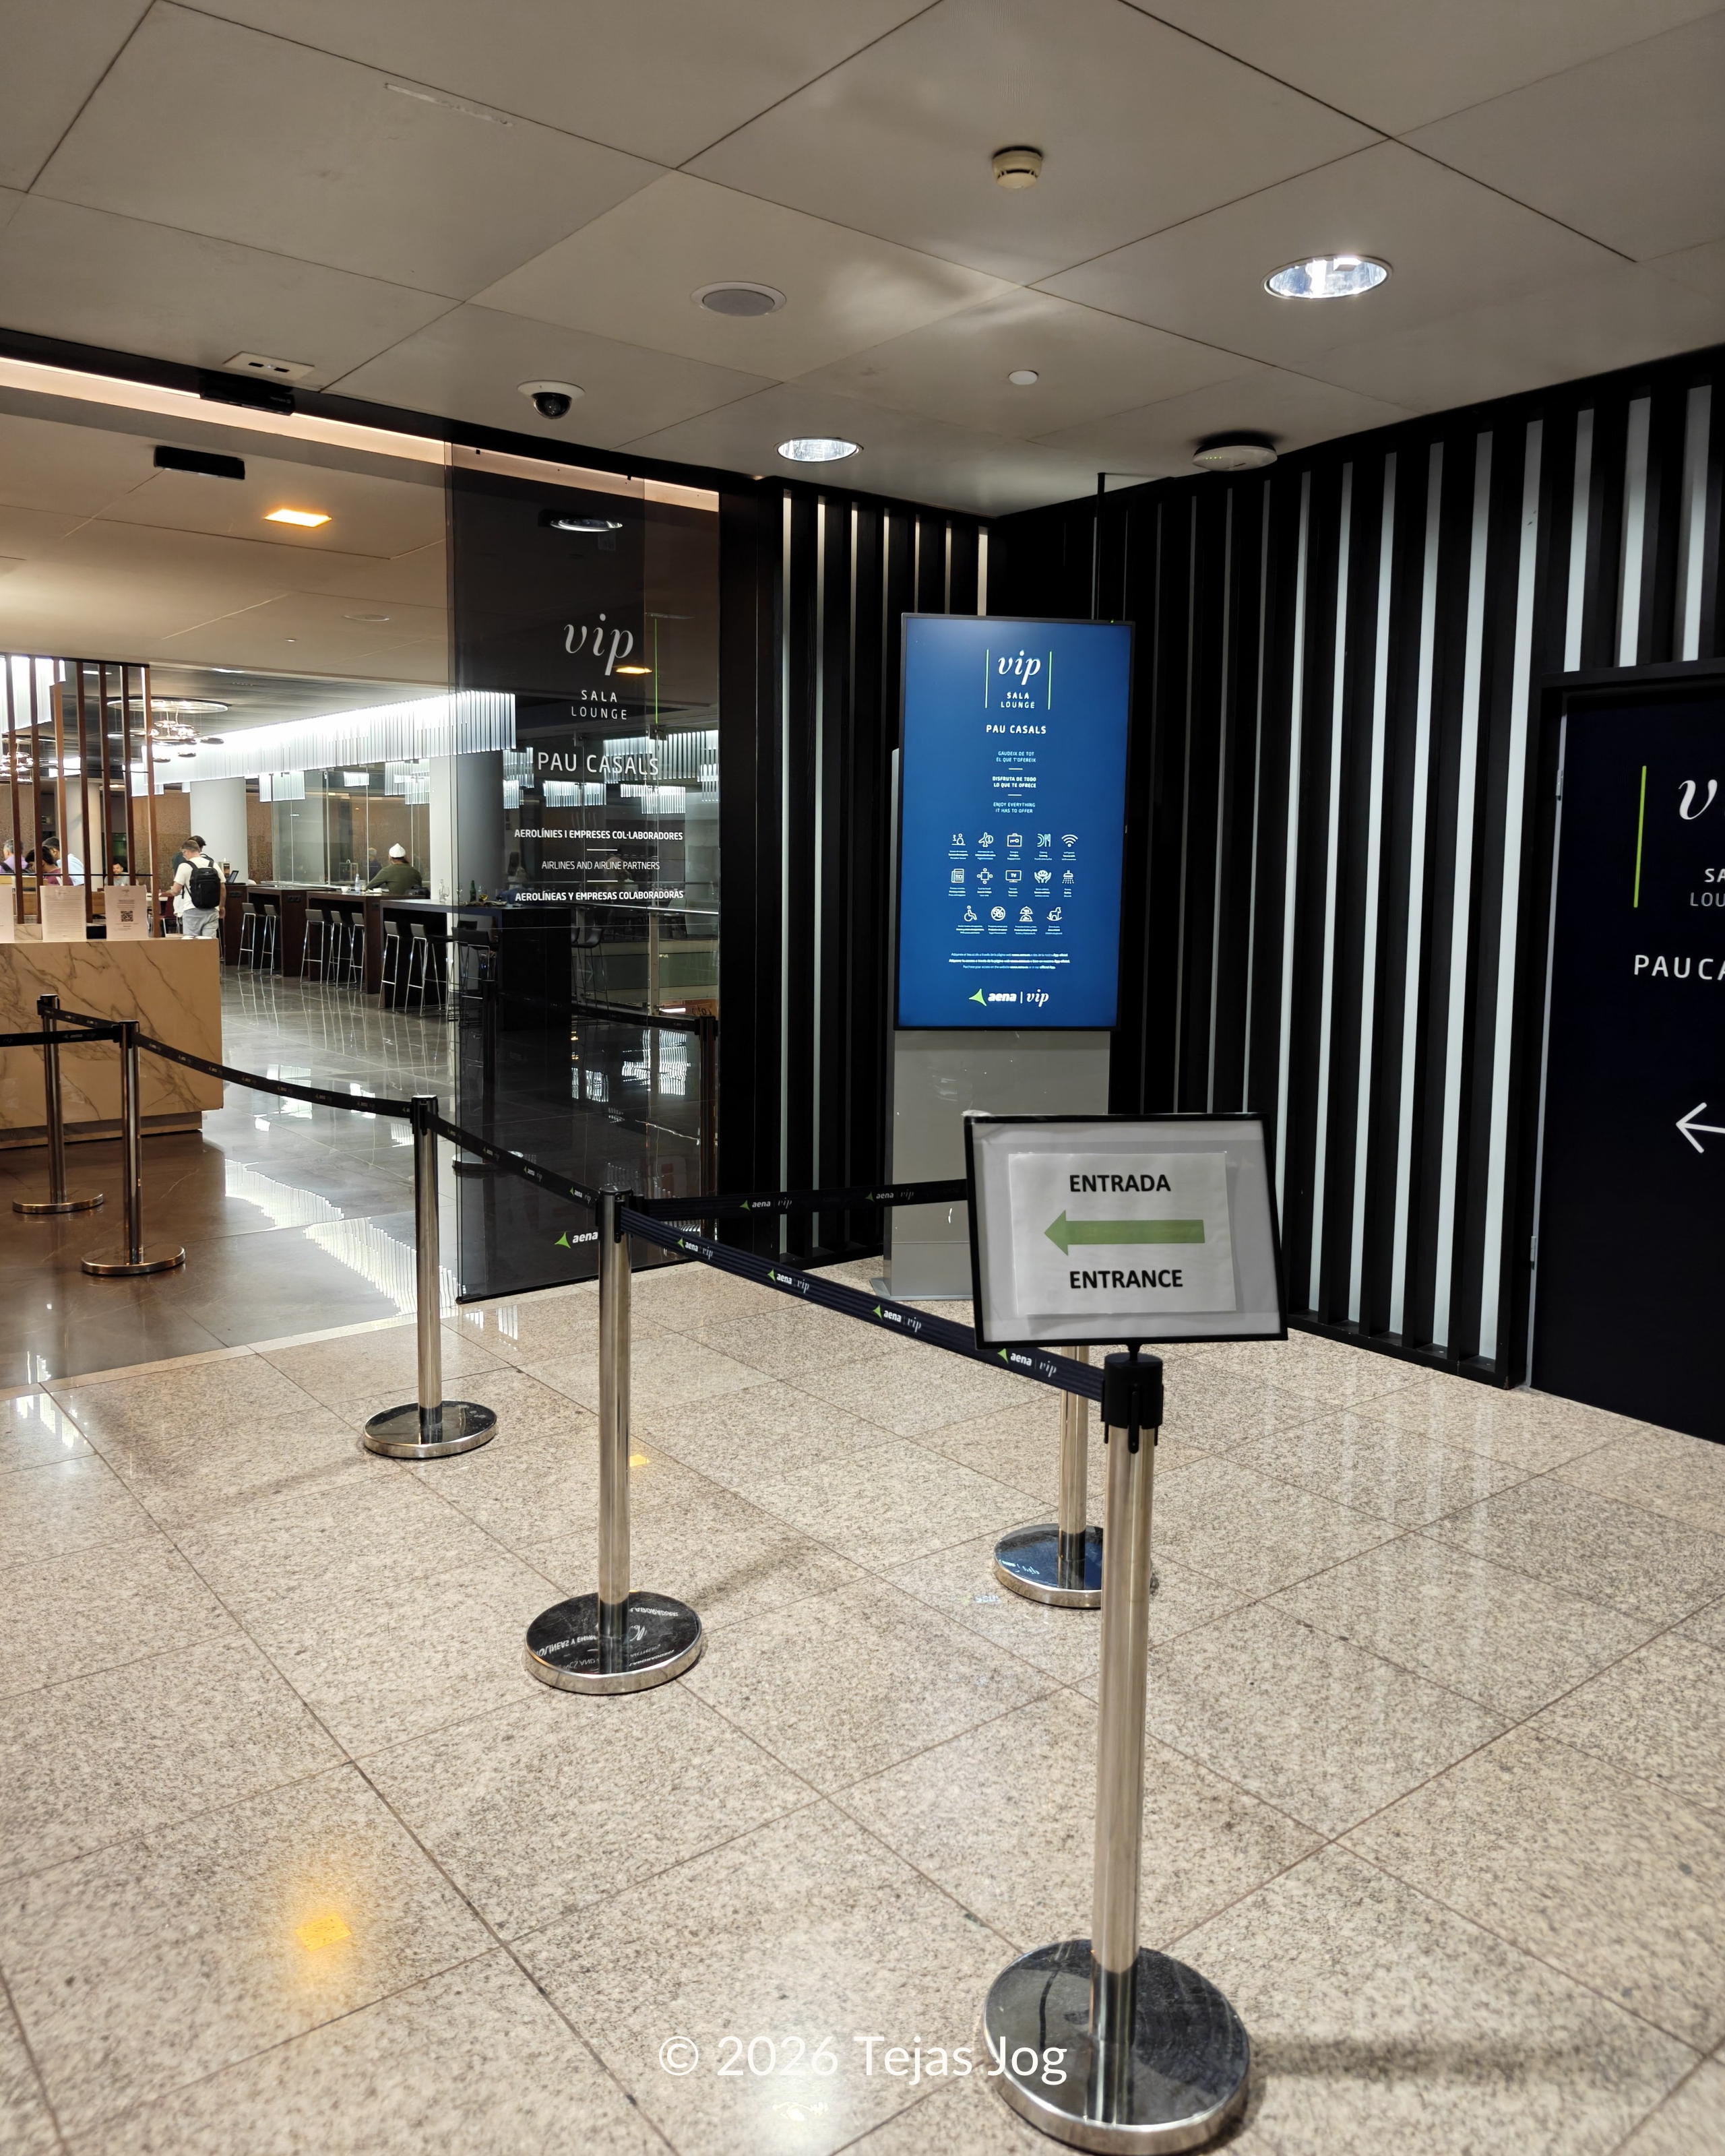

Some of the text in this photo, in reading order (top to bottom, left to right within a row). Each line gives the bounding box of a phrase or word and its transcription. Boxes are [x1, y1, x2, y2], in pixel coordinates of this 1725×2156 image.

[564, 613, 633, 676] vip
[998, 649, 1041, 685] vip
[581, 690, 618, 703] SALA
[1007, 691, 1030, 699] SALA
[571, 706, 627, 720] LOUNGE
[986, 724, 1046, 734] PAU CASALS
[538, 752, 659, 775] PAU CASALS
[514, 827, 563, 838] AEROLÍNIES
[564, 830, 567, 838] I
[569, 830, 610, 839] EMPRESES
[541, 860, 660, 870] AIRLINES AND AIRLINE PARTNERS
[1704, 868, 1725, 883] SA
[515, 891, 567, 901] AEROLÍNEAS
[575, 891, 617, 900] EMPRESAS
[619, 891, 684, 900] COLABORADORAS
[1690, 892, 1725, 907] LOU
[987, 988, 1049, 1007] aena vip
[1069, 1174, 1172, 1193] ENTRADA
[574, 1189, 583, 1198] aena
[572, 1231, 598, 1243] aena
[685, 1241, 698, 1253] aena
[776, 1273, 792, 1285] aena
[1069, 1269, 1183, 1290] ENTRANCE
[883, 1309, 902, 1323] aena
[1010, 1352, 1057, 1378] aena vip
